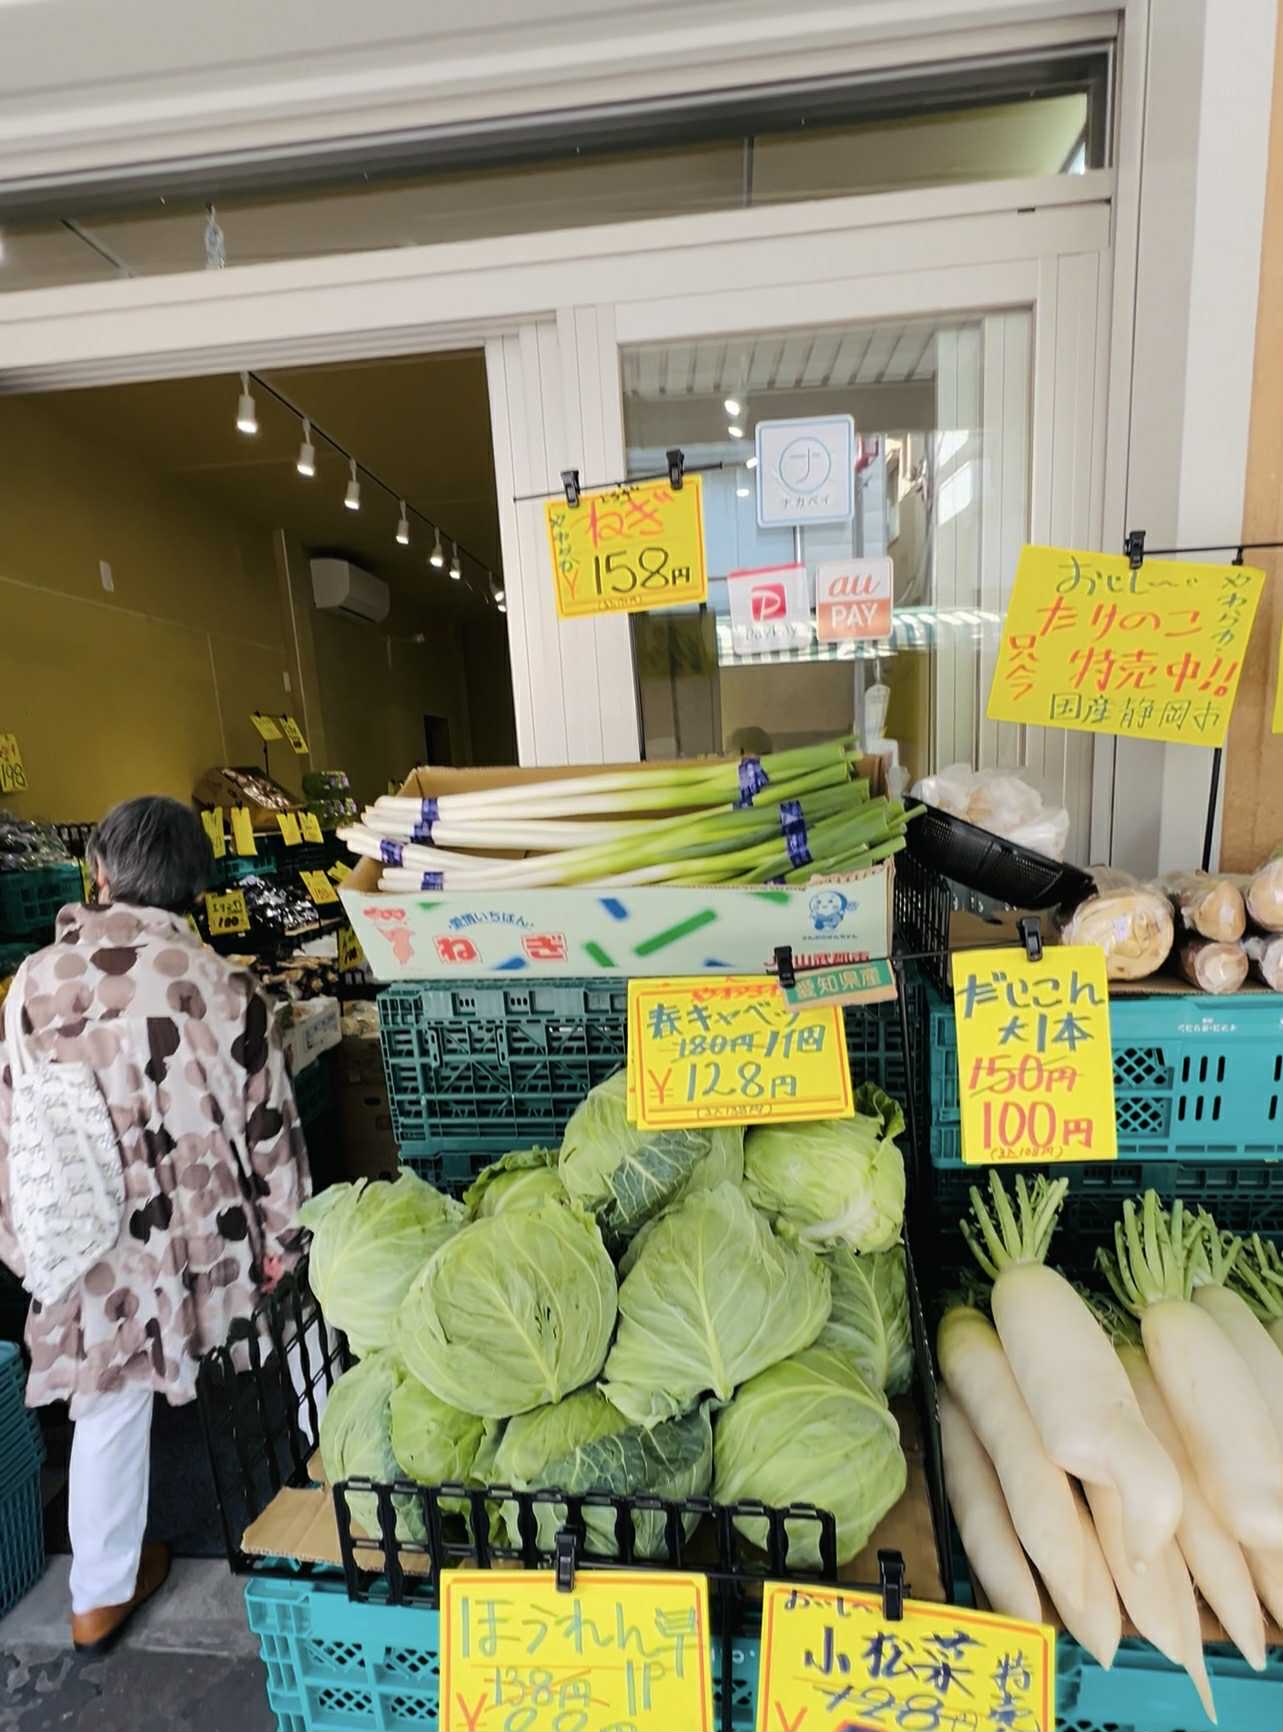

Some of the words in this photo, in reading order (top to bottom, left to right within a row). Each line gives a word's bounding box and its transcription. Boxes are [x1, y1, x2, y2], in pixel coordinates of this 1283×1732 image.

[570, 488, 673, 550] ねぎ
[828, 573, 881, 597] au
[831, 603, 880, 629] PAY
[796, 966, 881, 999] 愛知県産
[983, 1100, 1094, 1150] 100円
[804, 1625, 987, 1699] 小松菜
